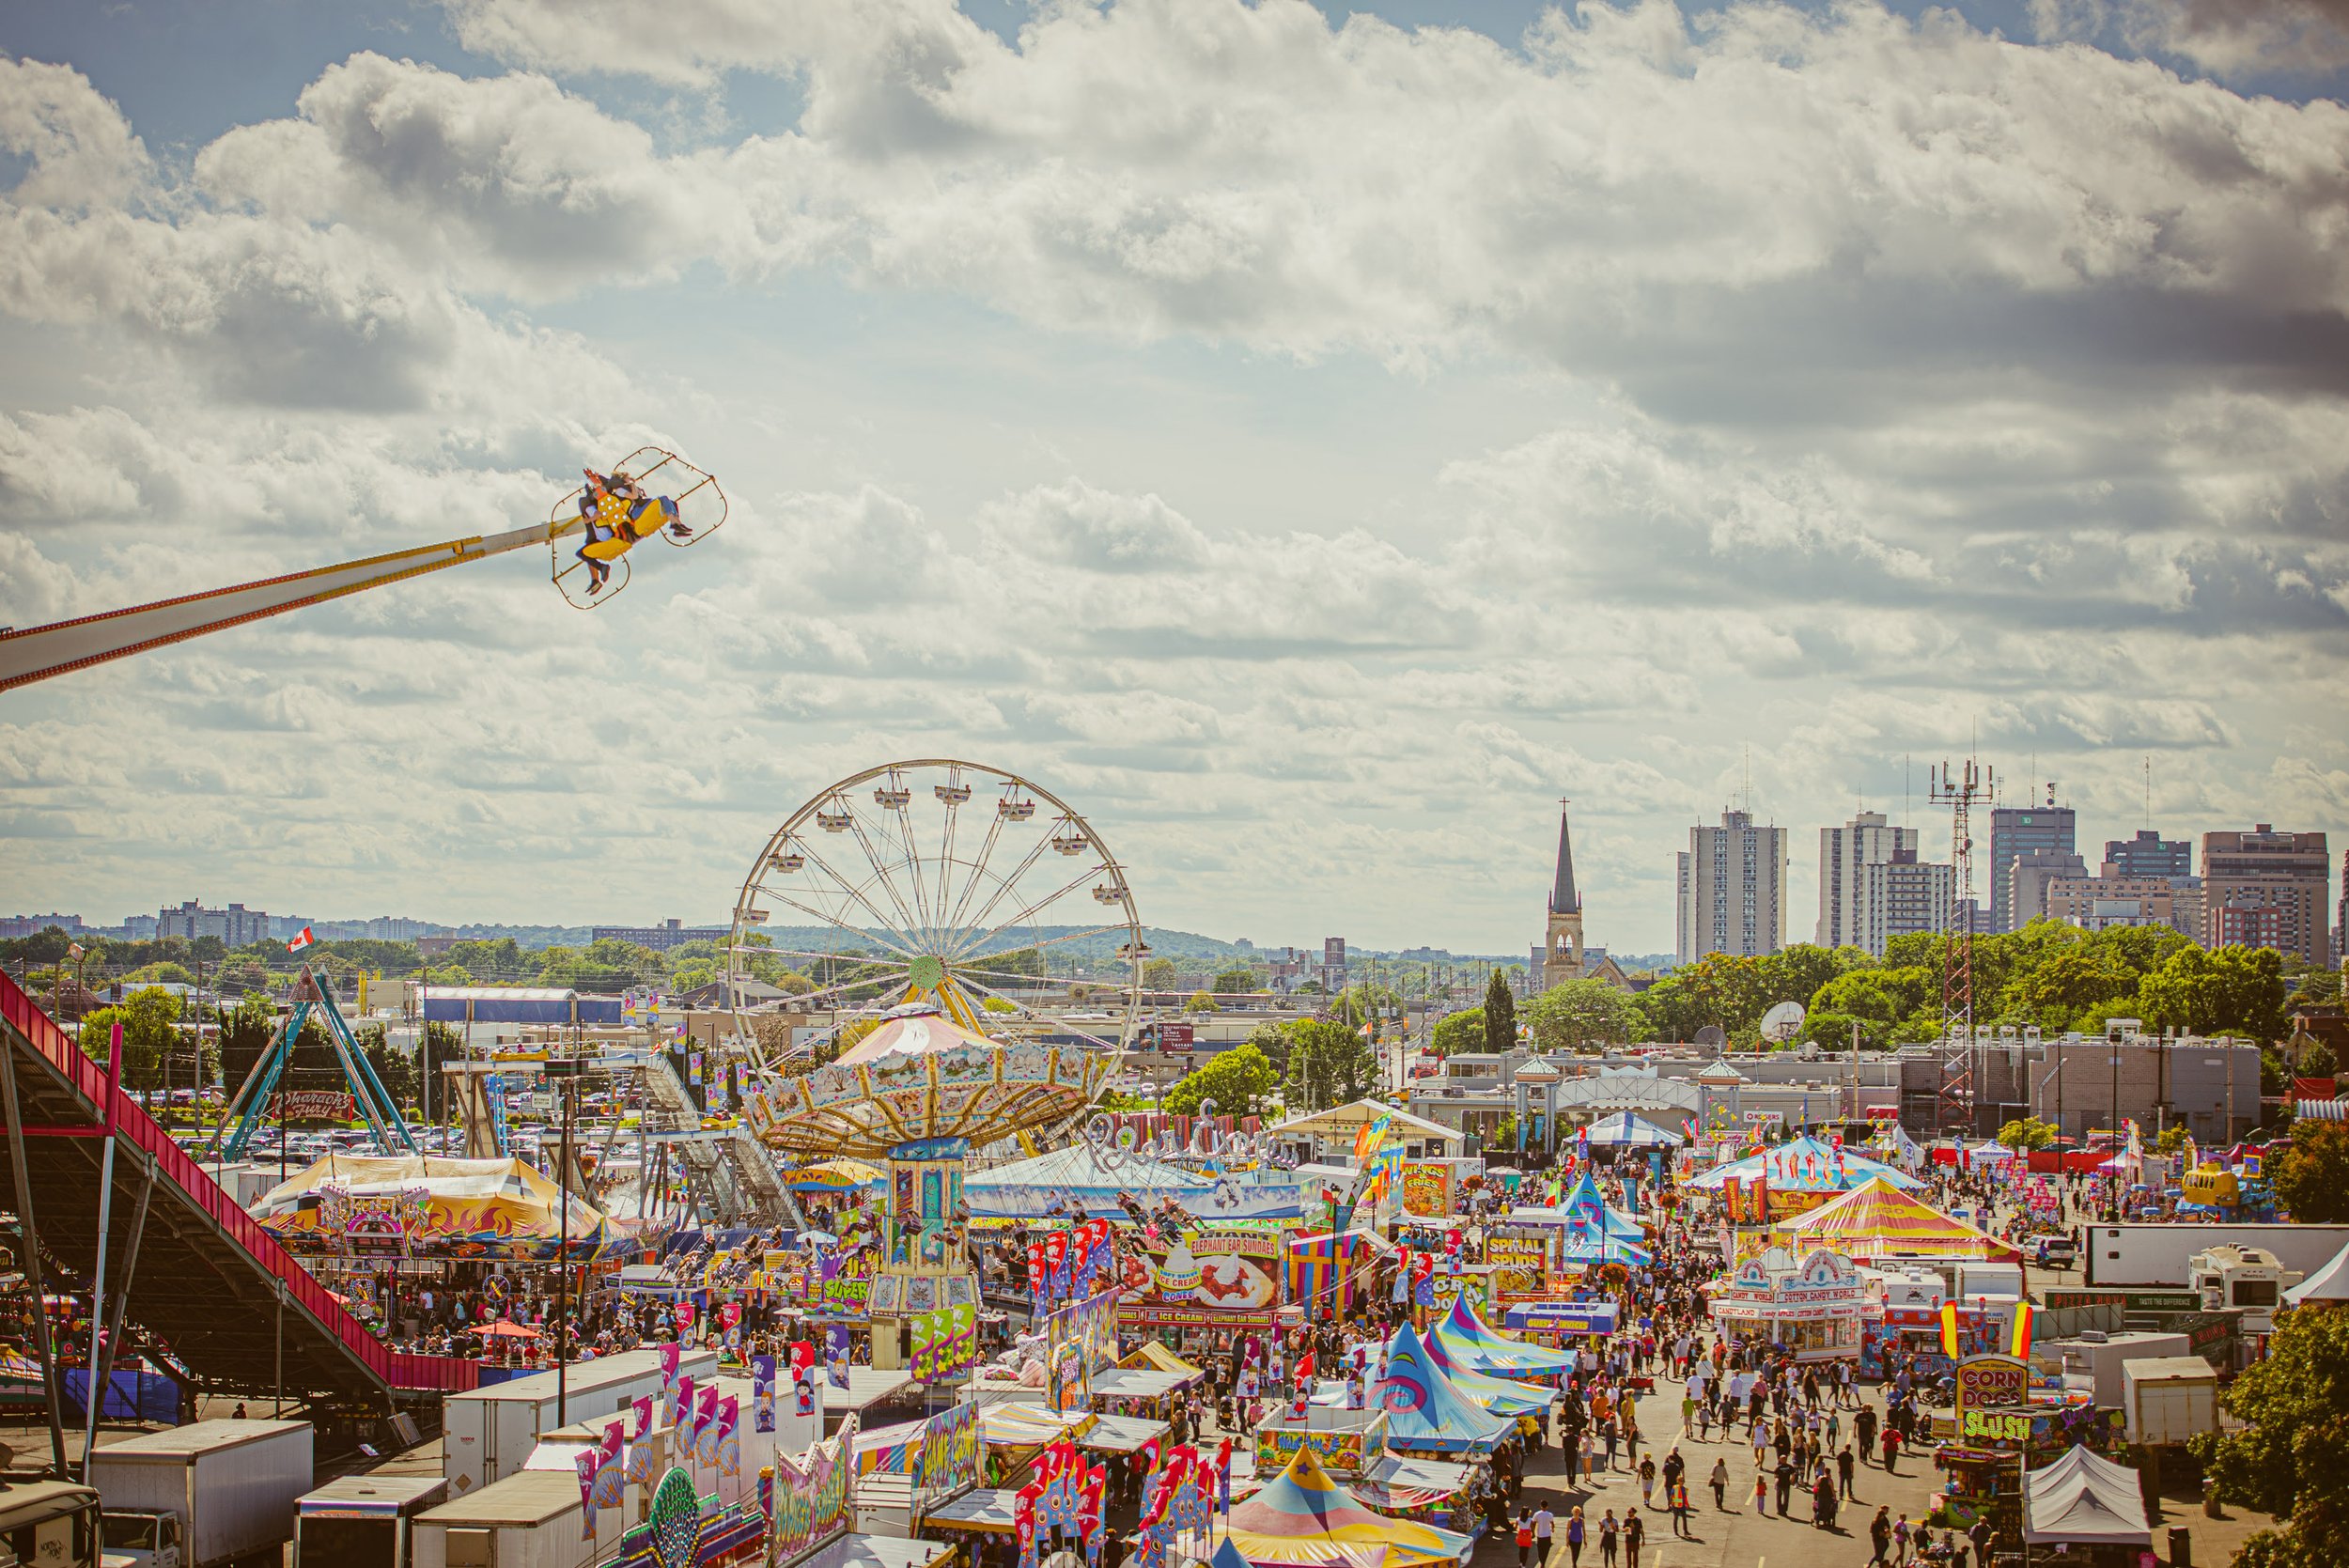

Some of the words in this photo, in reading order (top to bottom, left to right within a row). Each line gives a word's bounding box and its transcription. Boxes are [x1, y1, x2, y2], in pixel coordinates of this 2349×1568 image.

[1407, 1178, 1439, 1188] FRIES
[1191, 1239, 1225, 1253] ELEPHANT
[1228, 1239, 1240, 1251] EAR
[1243, 1240, 1275, 1255] SUNDAES
[1490, 1254, 1539, 1269] SPUDS
[1158, 1275, 1170, 1285] ICE
[1172, 1276, 1199, 1287] CREAM
[1162, 1290, 1194, 1302] CONES
[1754, 1293, 1773, 1301] WORLD
[1785, 1293, 1808, 1301] COTTON
[1810, 1291, 1830, 1299] CANDY
[1833, 1289, 1856, 1298] WORLD
[2054, 1294, 2091, 1308] PIZZA
[2139, 1297, 2154, 1306] TASTE
[2163, 1297, 2190, 1306] DIFFERENCE
[1718, 1307, 1755, 1316] CANDYLAND
[1174, 1313, 1203, 1322] CREAM
[1248, 1315, 1268, 1324] SUNDAES
[1559, 1320, 1588, 1329] ERVICES
[1962, 1370, 2022, 1388] CORN
[1962, 1390, 2021, 1408] DOGS
[1965, 1411, 2030, 1440] SLUSH
